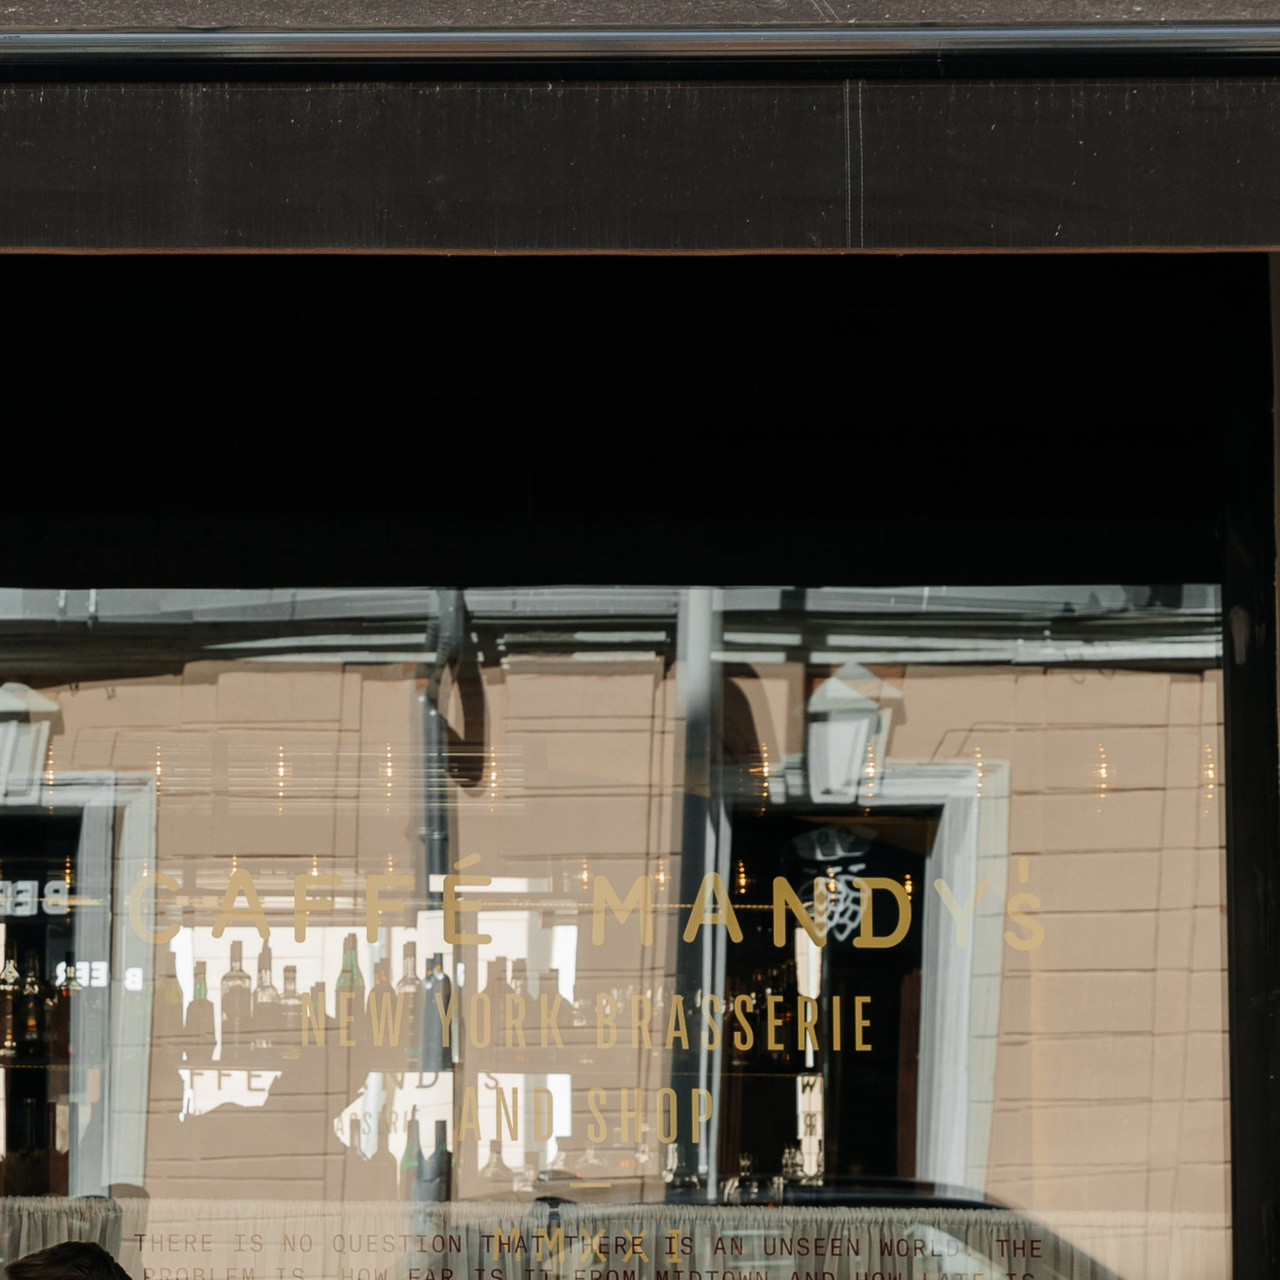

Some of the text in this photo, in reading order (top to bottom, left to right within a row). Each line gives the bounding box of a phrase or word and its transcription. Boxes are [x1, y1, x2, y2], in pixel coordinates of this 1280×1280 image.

[129, 853, 492, 946] CAFFÉ
[301, 992, 873, 1052] NEW YORK BRASSERIE
[458, 1086, 554, 1142] AND
[587, 1087, 713, 1144] SHOP
[134, 1234, 213, 1253] THERE
[234, 1234, 263, 1253] IS
[283, 1234, 313, 1253] NO
[332, 1234, 462, 1254] QUESTION
[481, 1235, 545, 1254] THAT
[564, 1236, 644, 1255] THERE
[665, 1236, 694, 1255] IS
[713, 1237, 744, 1255] AN
[763, 1237, 860, 1257] UNSEEN
[995, 1239, 1042, 1258] THE
